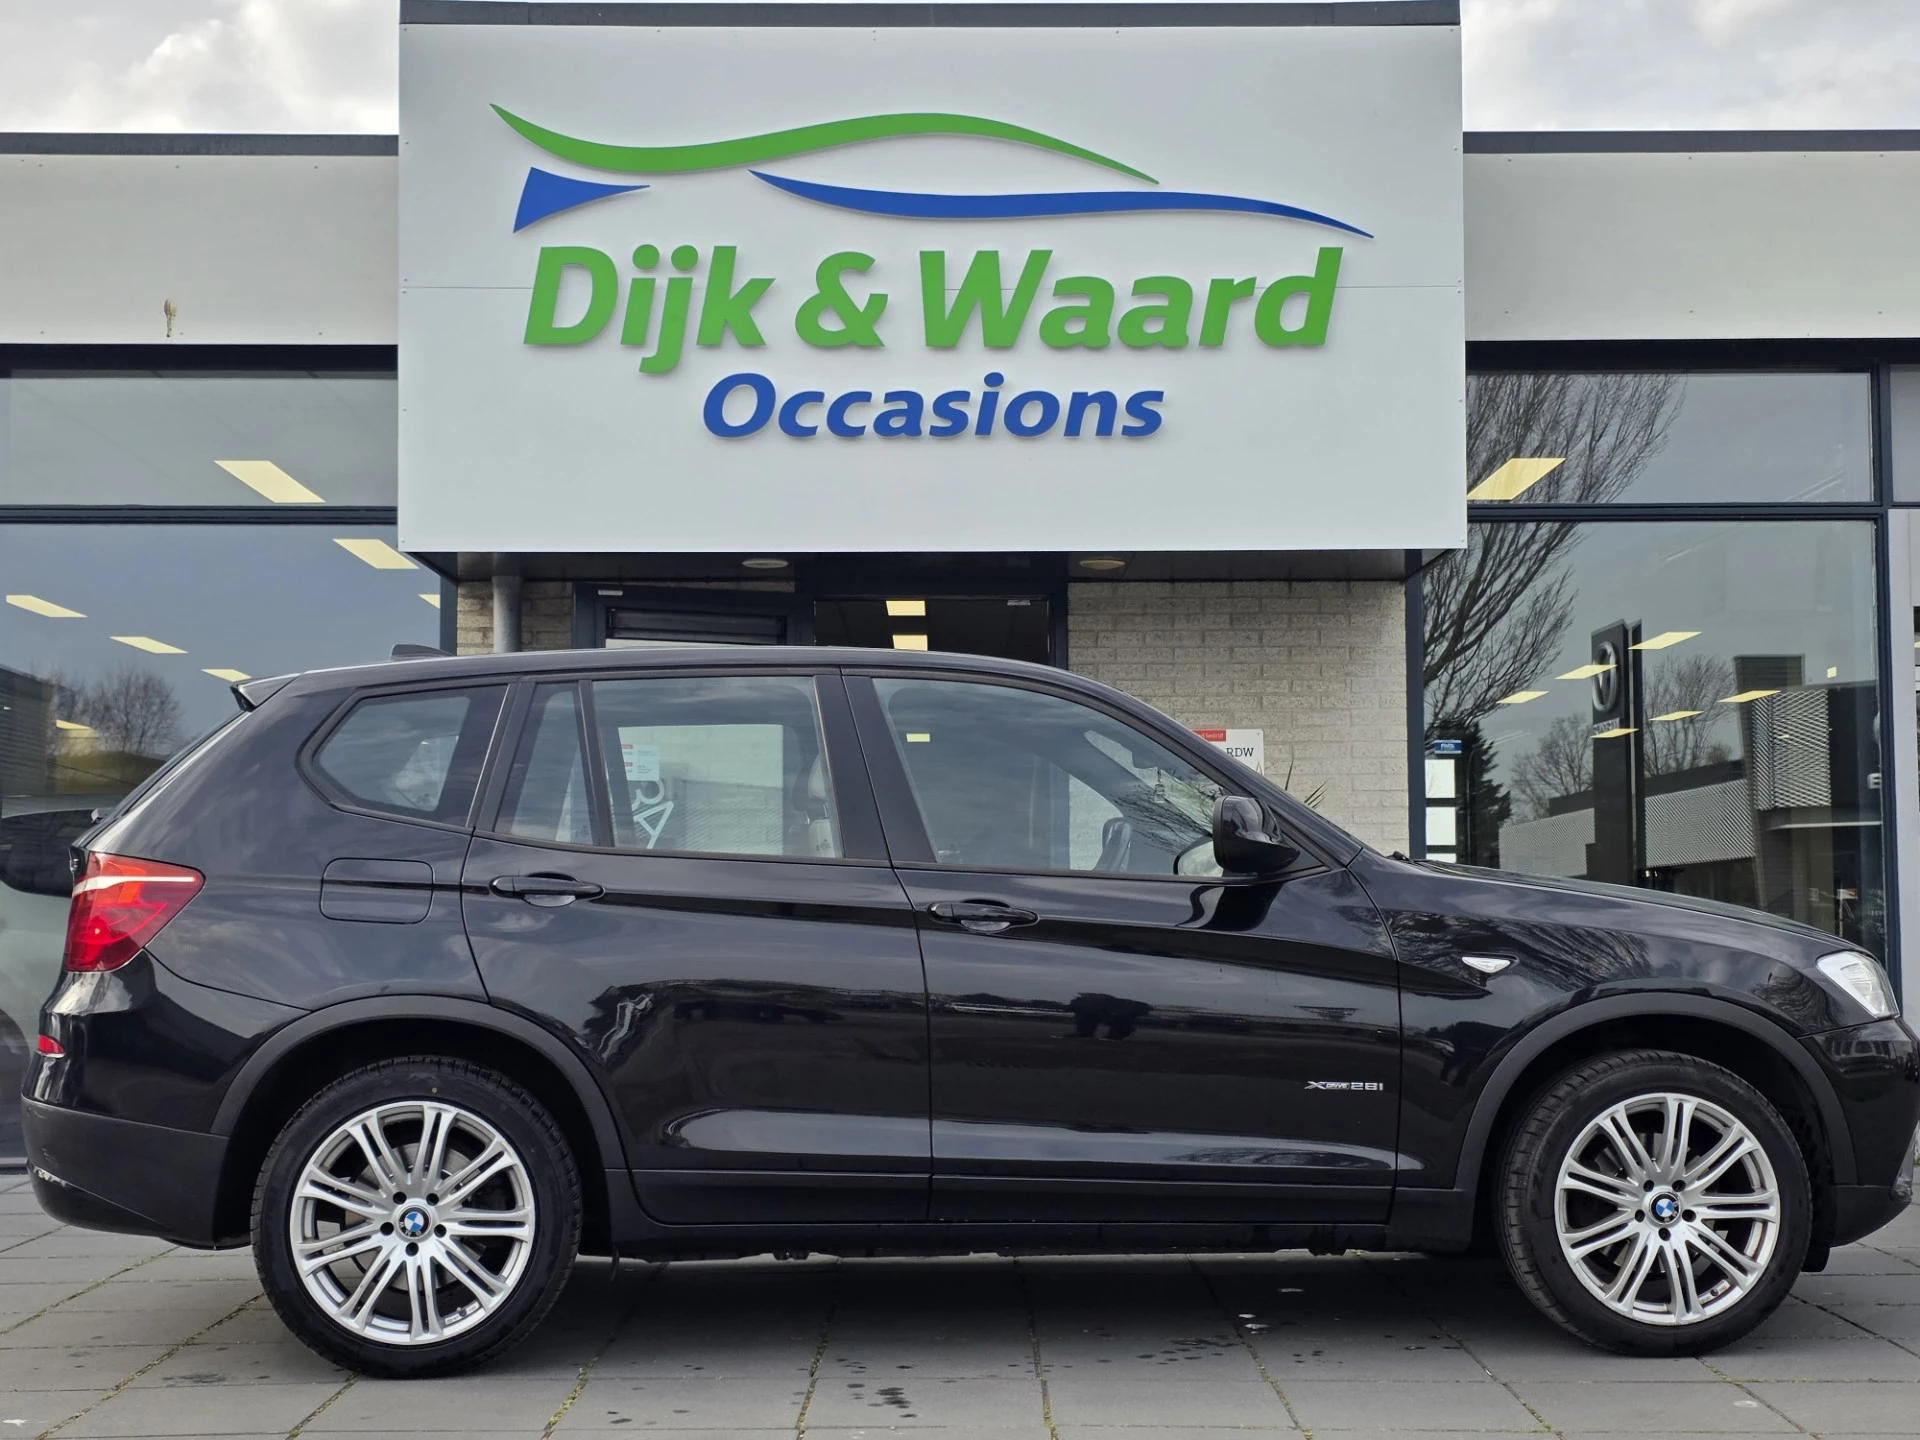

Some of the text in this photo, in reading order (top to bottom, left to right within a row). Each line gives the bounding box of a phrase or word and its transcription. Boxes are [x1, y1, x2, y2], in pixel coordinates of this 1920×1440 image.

[524, 245, 1344, 373] Dijk & Waard
[703, 371, 1165, 438] Occasions
[1226, 747, 1254, 757] RDW
